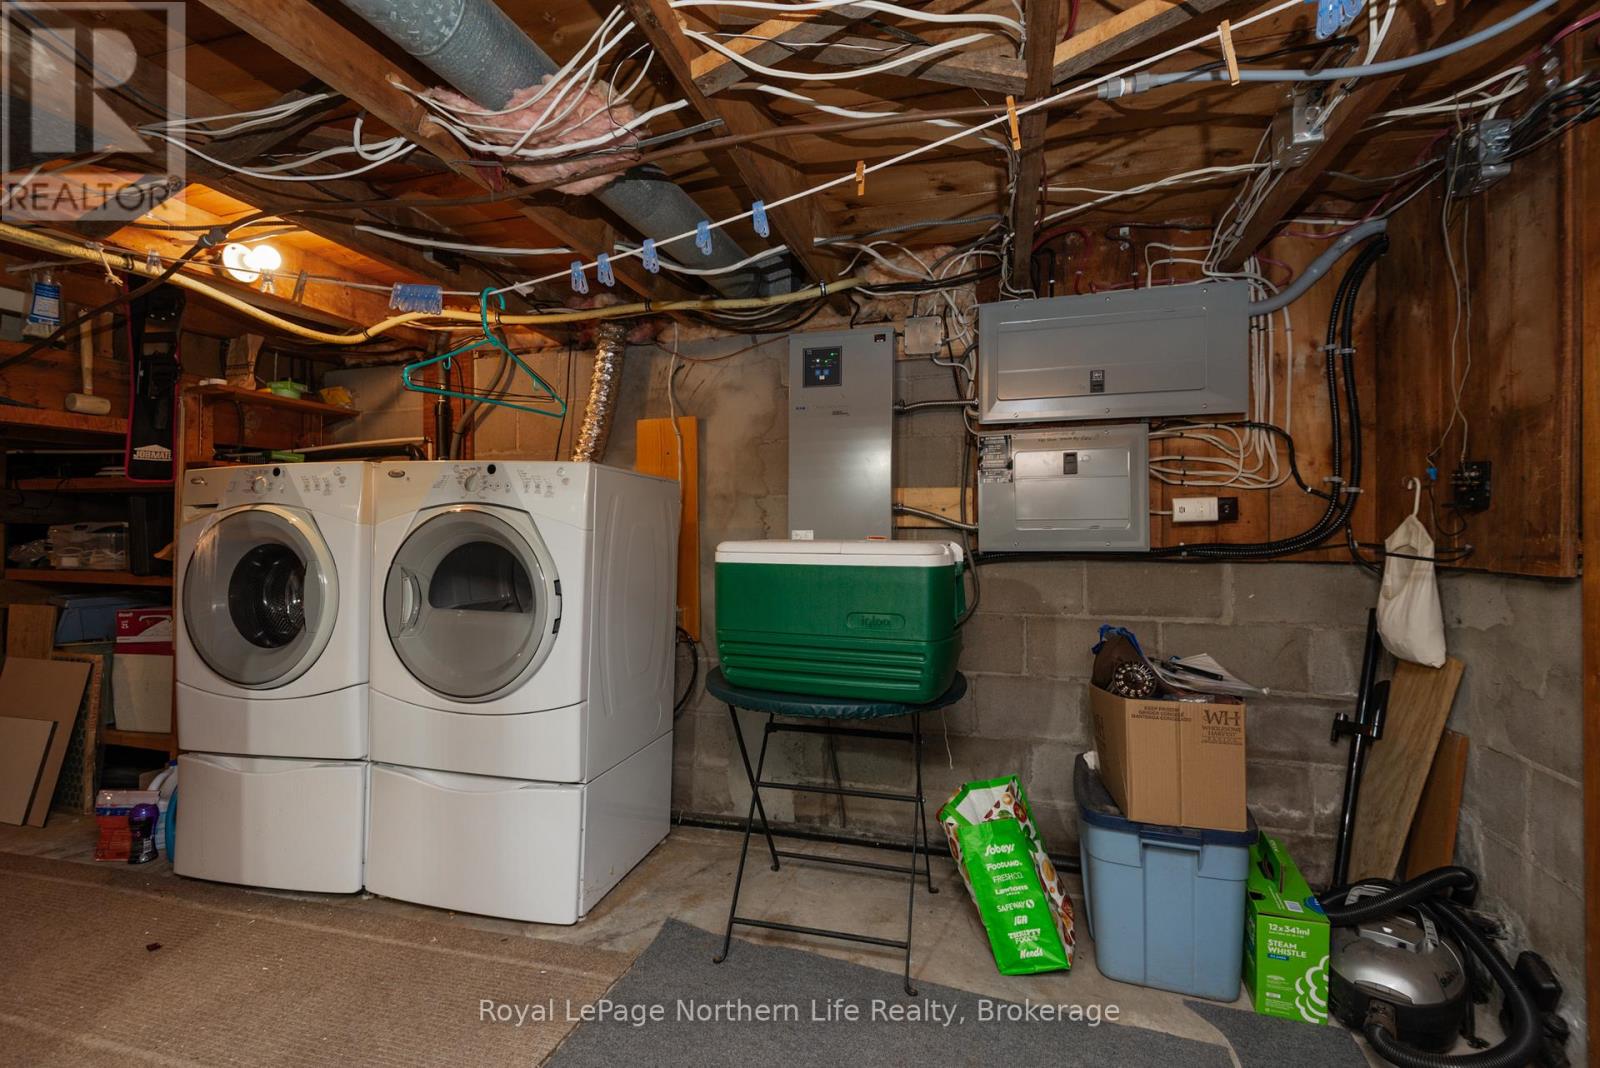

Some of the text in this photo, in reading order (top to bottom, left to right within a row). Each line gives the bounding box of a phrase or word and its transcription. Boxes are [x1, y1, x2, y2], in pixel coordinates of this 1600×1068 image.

[1204, 709, 1241, 726] WH
[985, 843, 1015, 857] Sobeys
[997, 901, 1025, 912] SAFEWAY
[1268, 940, 1297, 949] STEAM
[1268, 946, 1307, 958] WHISTLE
